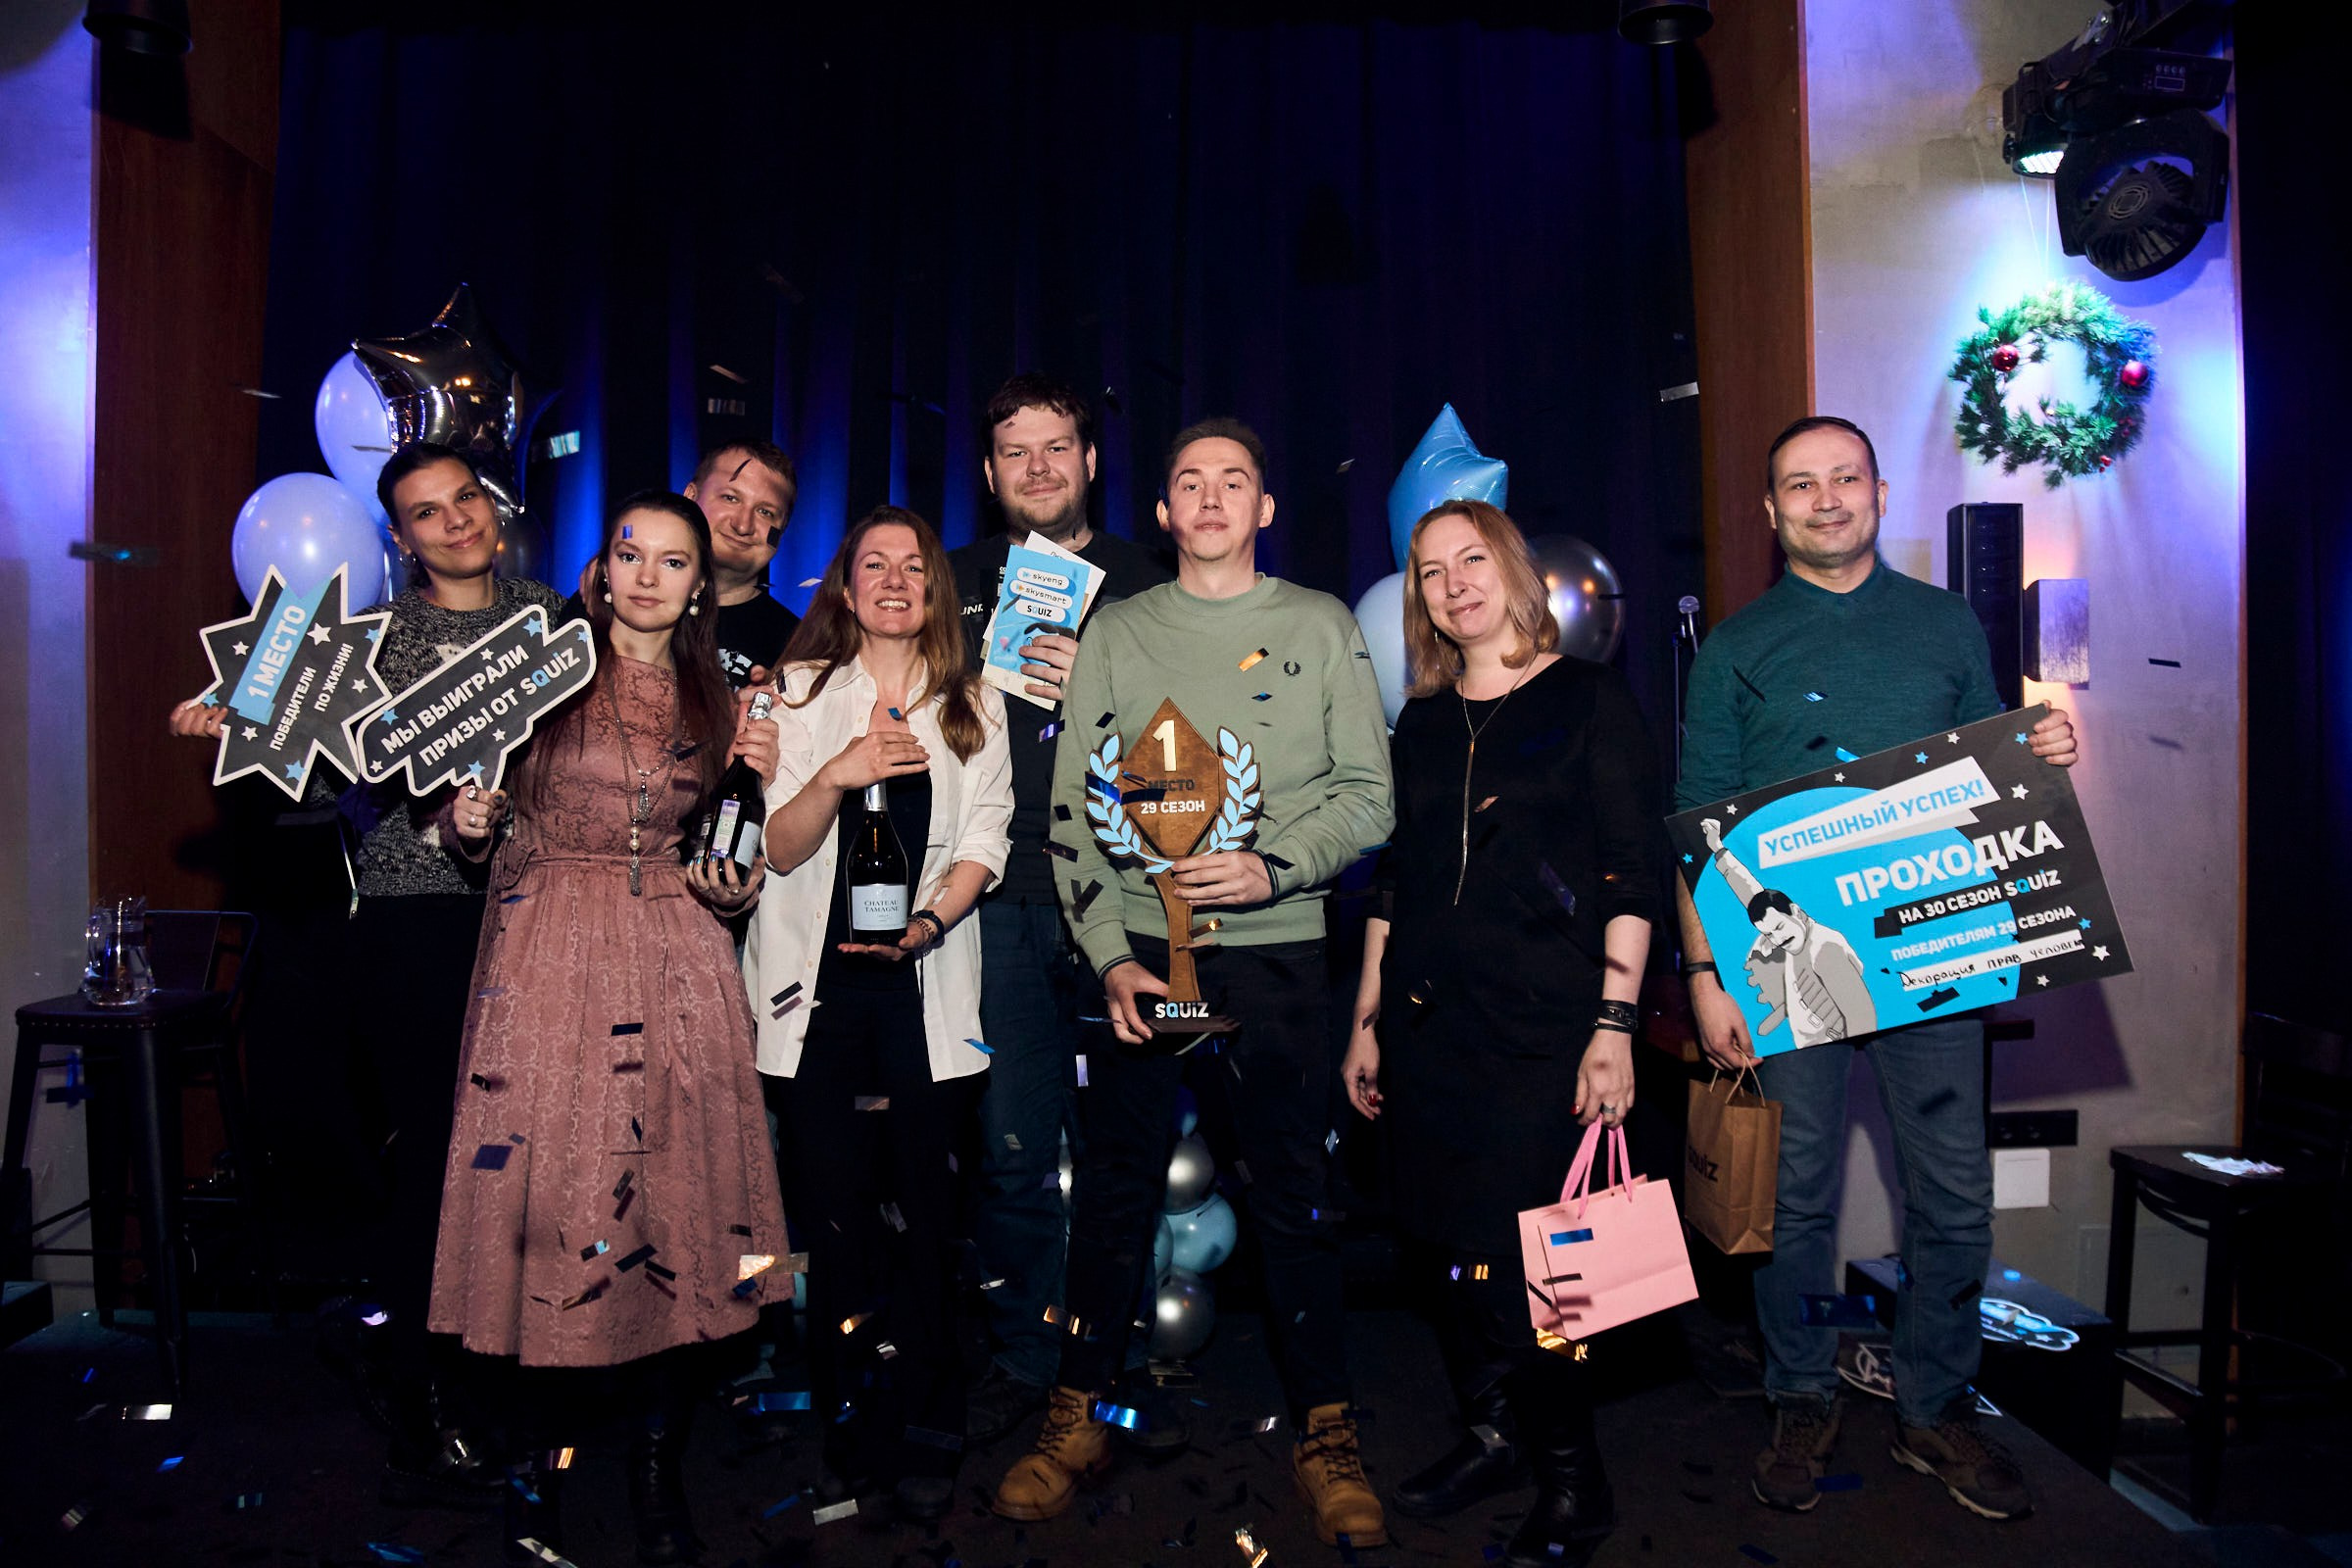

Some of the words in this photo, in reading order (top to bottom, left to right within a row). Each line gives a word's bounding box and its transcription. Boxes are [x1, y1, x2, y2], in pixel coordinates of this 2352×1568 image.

[1025, 587, 1067, 605] skysmart
[1032, 573, 1063, 586] skyeng
[253, 605, 307, 687] МЕСТО
[247, 685, 270, 699] 1
[314, 693, 331, 712] ПО
[323, 643, 355, 694] ЖИЗНИ!
[380, 718, 421, 755] МЫ
[416, 644, 529, 729] ВЫИГРАЛИ
[269, 666, 318, 752] ПОБЕДИТЕЛИ
[418, 707, 494, 767] ПРИЗЫ
[490, 688, 518, 716] ОТ
[1152, 719, 1177, 772] 1
[1140, 802, 1157, 814] 29
[1160, 800, 1206, 813] СЕЗОН
[1148, 779, 1195, 792] МЕСТО
[1764, 800, 1899, 857] УСПЕШНЫЙ
[1899, 779, 1986, 817] УСПЕХ!
[1835, 820, 2065, 906] ПРОХОДКА
[1897, 906, 1925, 925] НА
[1926, 901, 1946, 918] 30
[1948, 886, 2002, 912] СЕЗОН
[1890, 924, 1996, 962] ПОБЕДИТЕЛЯМ
[1997, 919, 2017, 936] 29
[2018, 906, 2077, 930] СЕЗОНА
